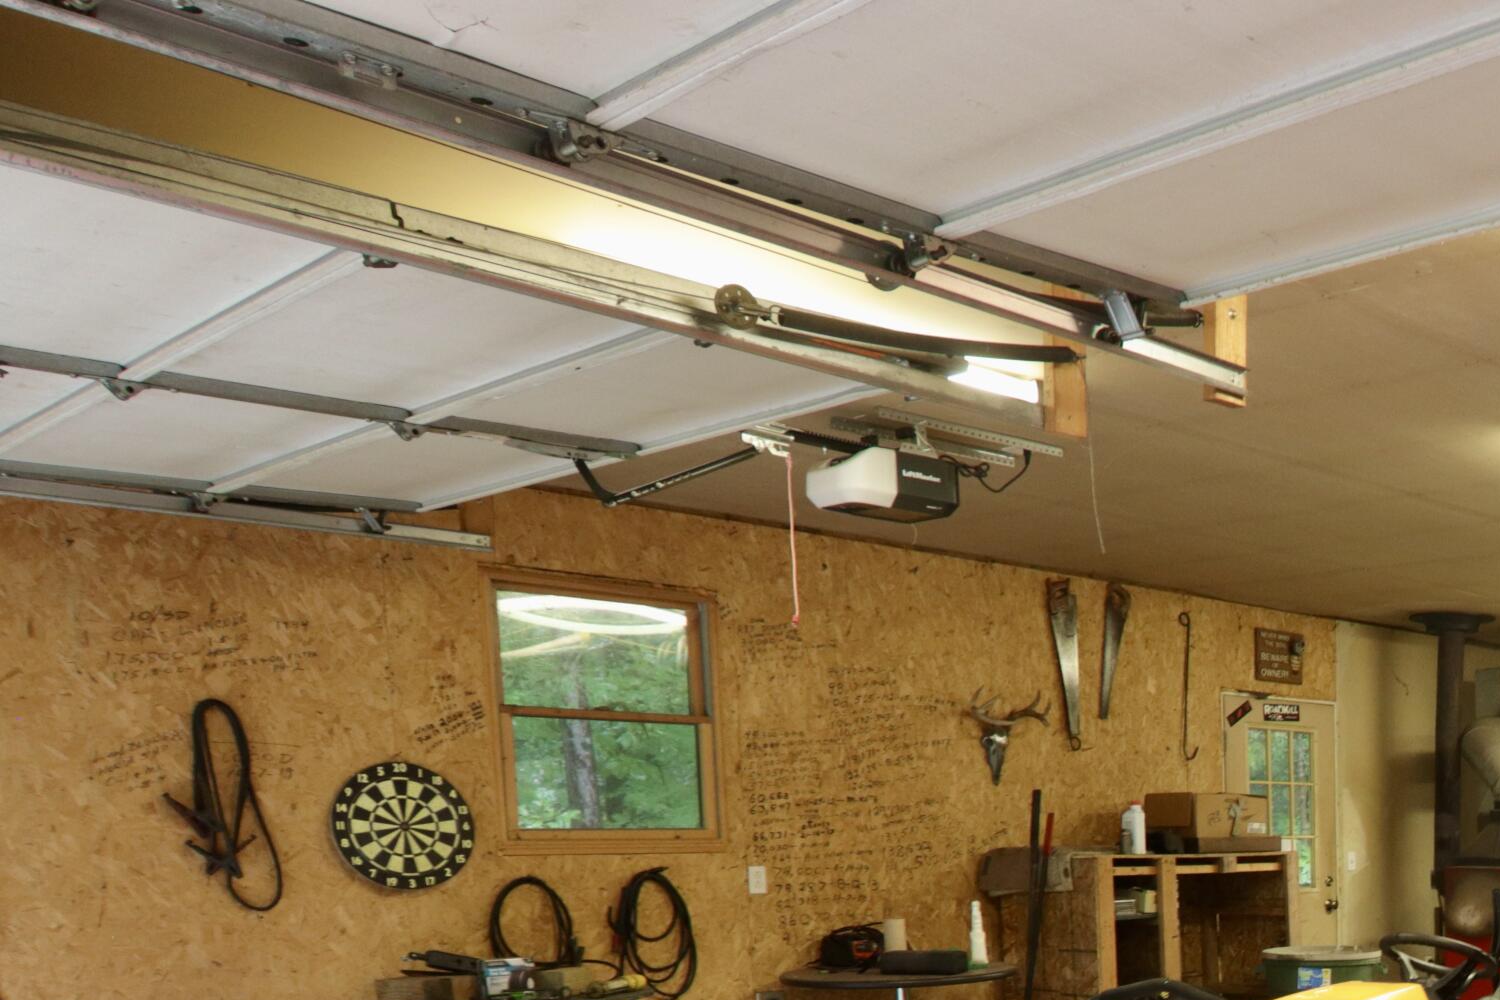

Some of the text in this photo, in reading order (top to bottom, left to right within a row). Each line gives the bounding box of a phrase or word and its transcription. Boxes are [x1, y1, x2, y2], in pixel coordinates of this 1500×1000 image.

[902, 469, 941, 483] LiftMaster
[1260, 652, 1289, 663] BEWARE
[377, 767, 385, 776] 5
[393, 763, 407, 772] 20
[417, 769, 423, 778] 1
[357, 774, 369, 783] 12
[344, 787, 352, 797] 9
[450, 790, 457, 798] 4
[336, 803, 347, 812] 14
[458, 805, 468, 814] 13
[336, 821, 345, 830] 11
[463, 822, 471, 831] 6
[341, 838, 350, 848] 8
[462, 840, 473, 848] 10
[352, 857, 363, 866] 16
[456, 854, 466, 863] 15
[369, 869, 377, 878] 7
[445, 868, 452, 877] 2
[386, 877, 398, 886] 19
[409, 879, 416, 888] 3
[425, 876, 436, 885] 17
